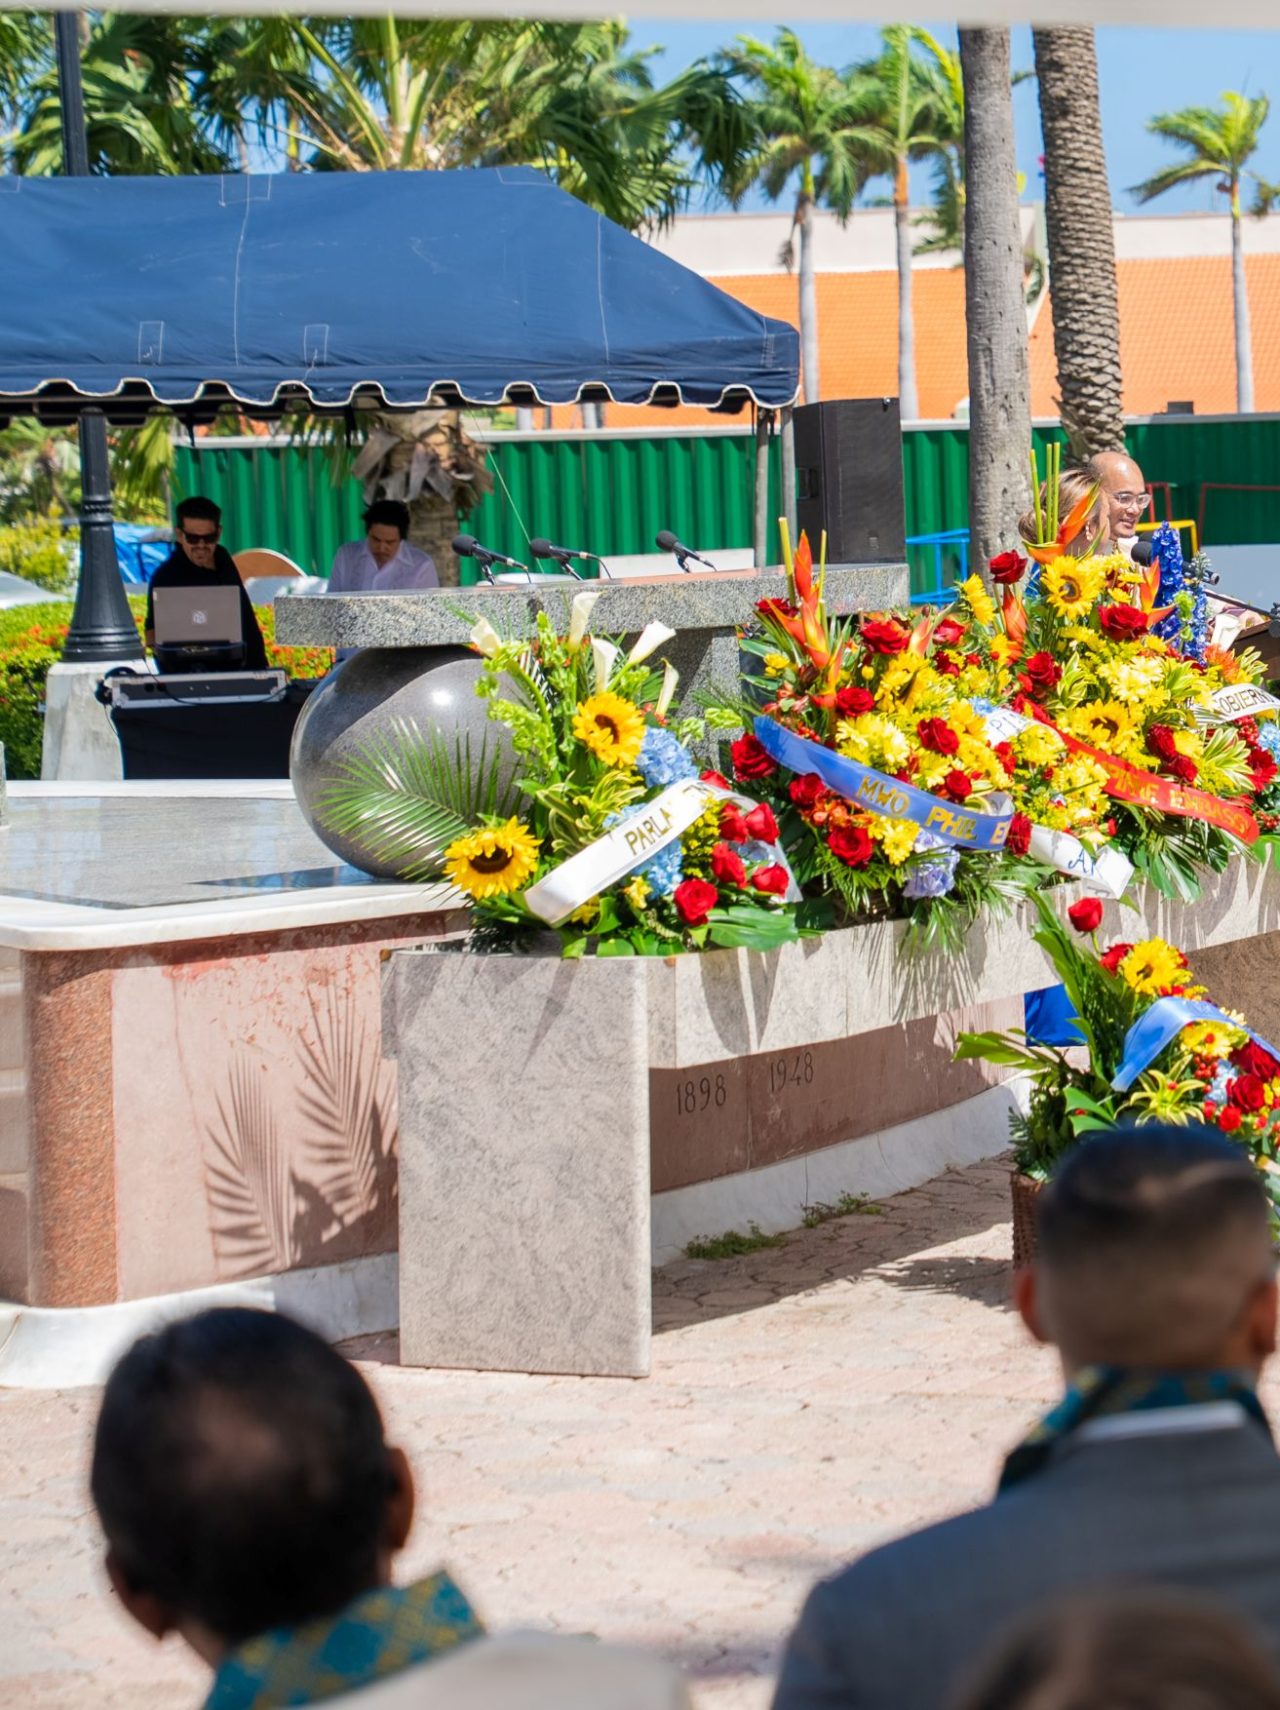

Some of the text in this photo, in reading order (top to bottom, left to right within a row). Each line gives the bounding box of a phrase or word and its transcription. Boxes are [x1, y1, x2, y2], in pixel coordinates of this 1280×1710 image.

[1218, 688, 1276, 715] OBIERN
[856, 775, 910, 817] MWO
[925, 805, 979, 841] PHIL
[676, 1051, 814, 1115] 1898 1948
